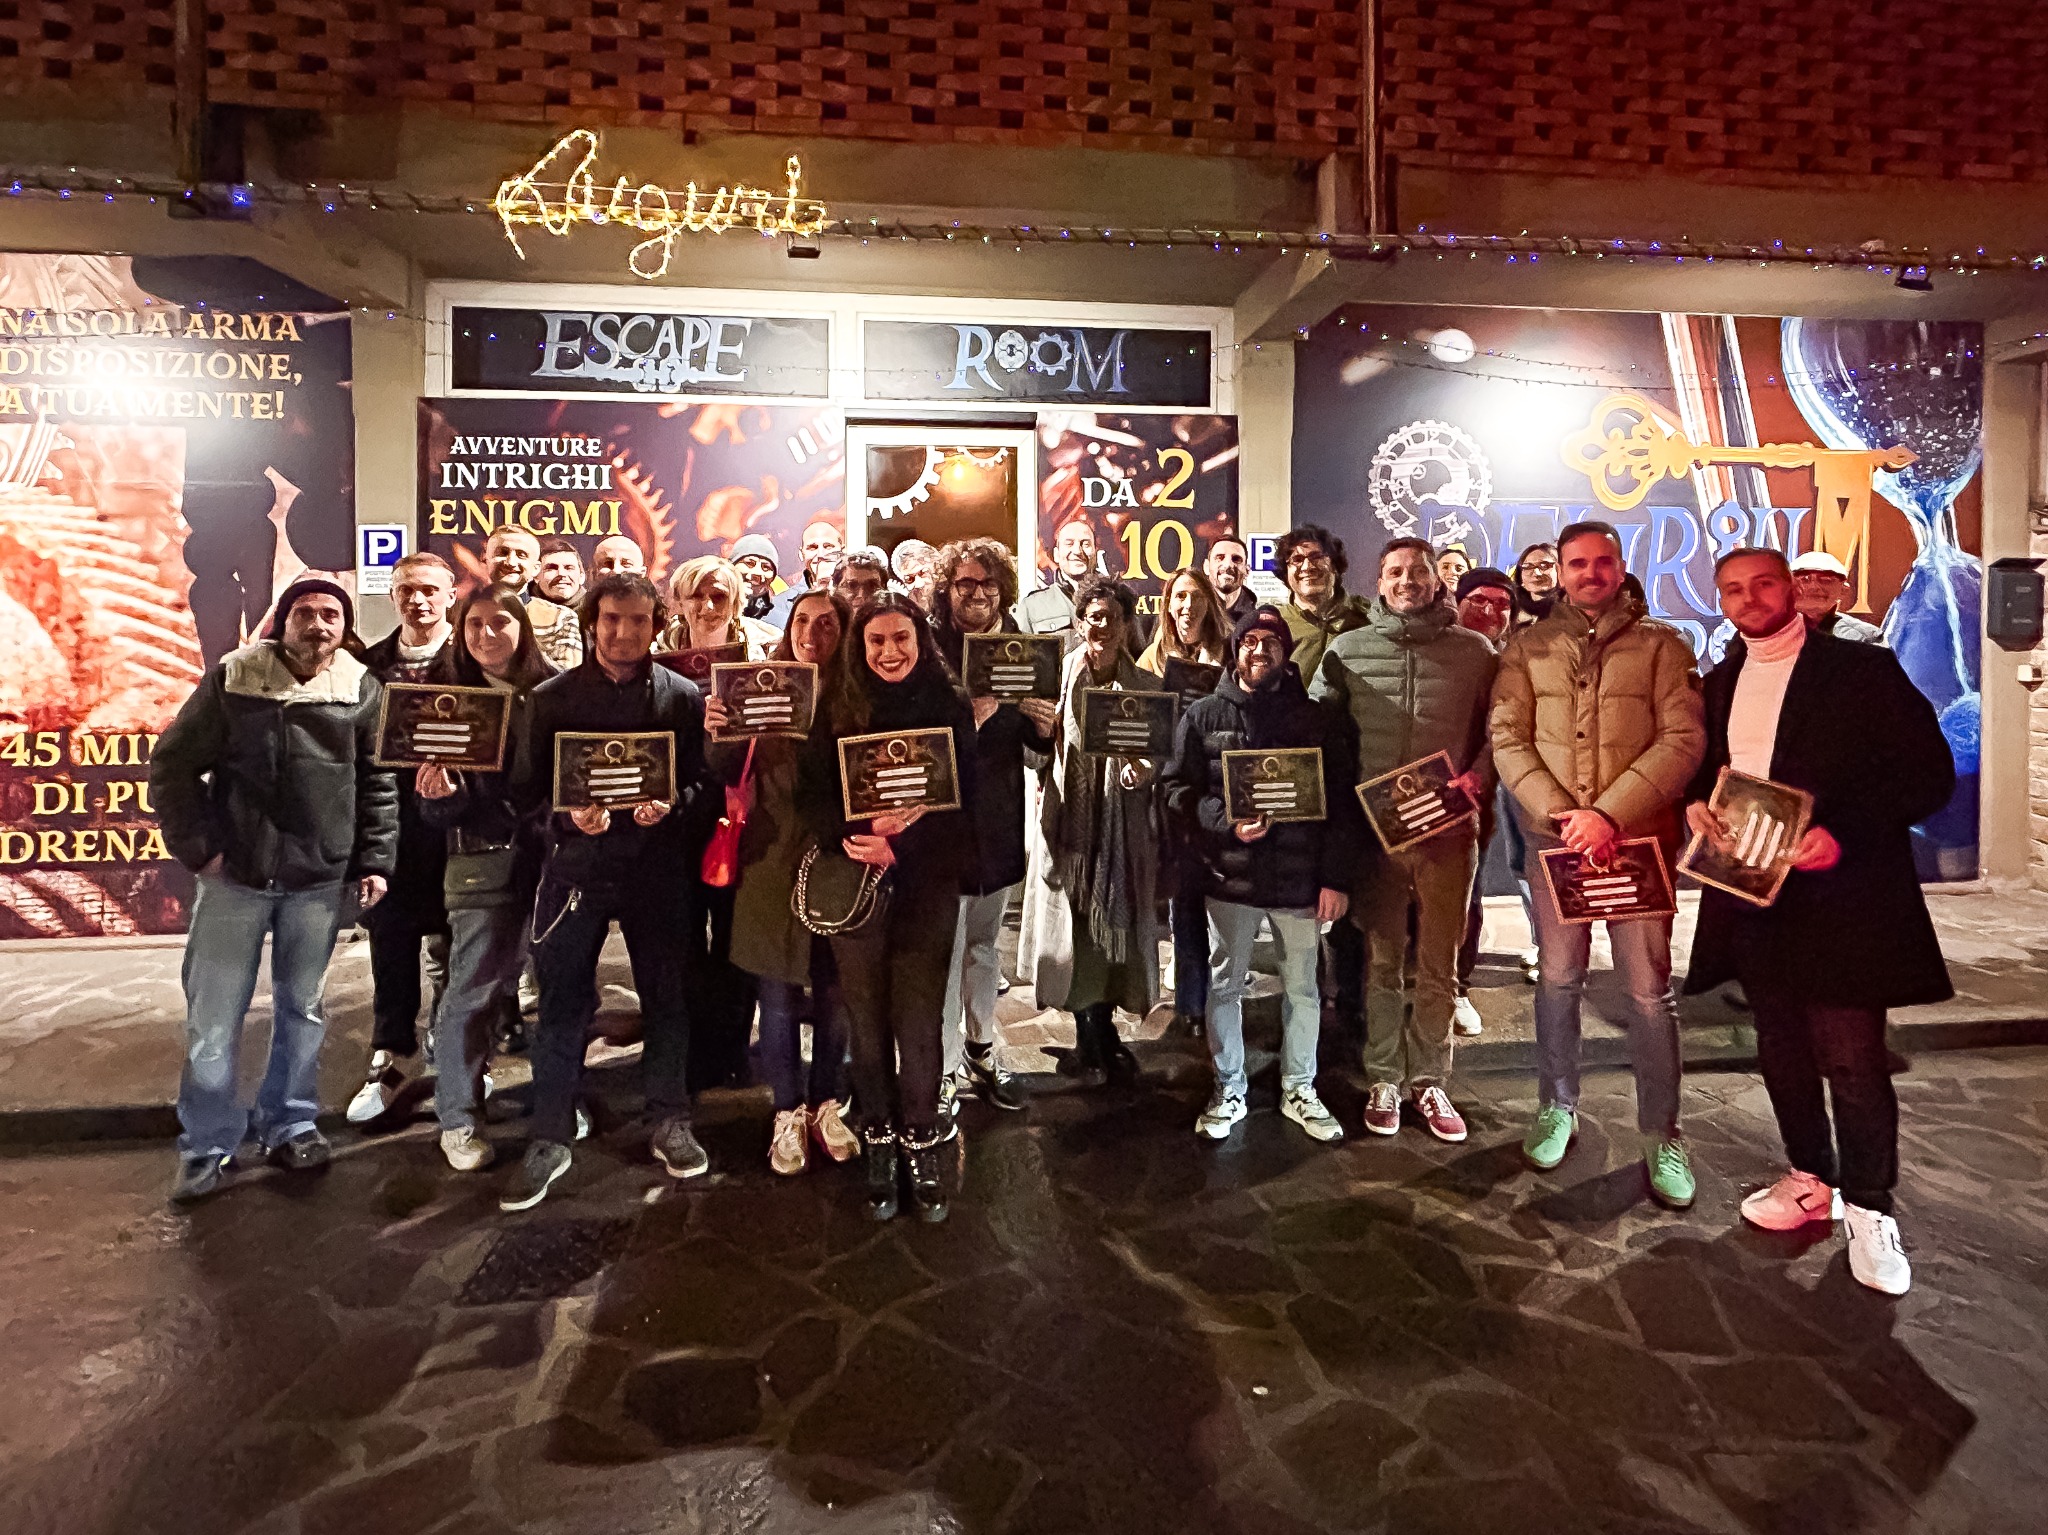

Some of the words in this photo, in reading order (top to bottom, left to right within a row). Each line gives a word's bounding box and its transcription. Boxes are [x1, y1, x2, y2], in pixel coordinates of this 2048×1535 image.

[57, 310, 173, 338] SOLA
[182, 312, 304, 342] ARMA
[531, 312, 753, 382] ESCAPE
[942, 325, 1130, 393] ROOM
[0, 347, 303, 386] DISPOSIZIONE,
[40, 388, 120, 417] TUA
[126, 390, 286, 420] MENTE!
[450, 436, 602, 457] AVVENTURE
[440, 462, 613, 490] INTRIGHI
[1081, 477, 1140, 507] DA
[1151, 448, 1195, 510] 2
[429, 499, 623, 537] ENIGMI
[368, 531, 398, 565] P
[1120, 519, 1195, 580] 10
[1255, 540, 1277, 570] P
[1, 732, 61, 767] 45
[32, 782, 88, 815] DI
[0, 828, 173, 864] DRENA
